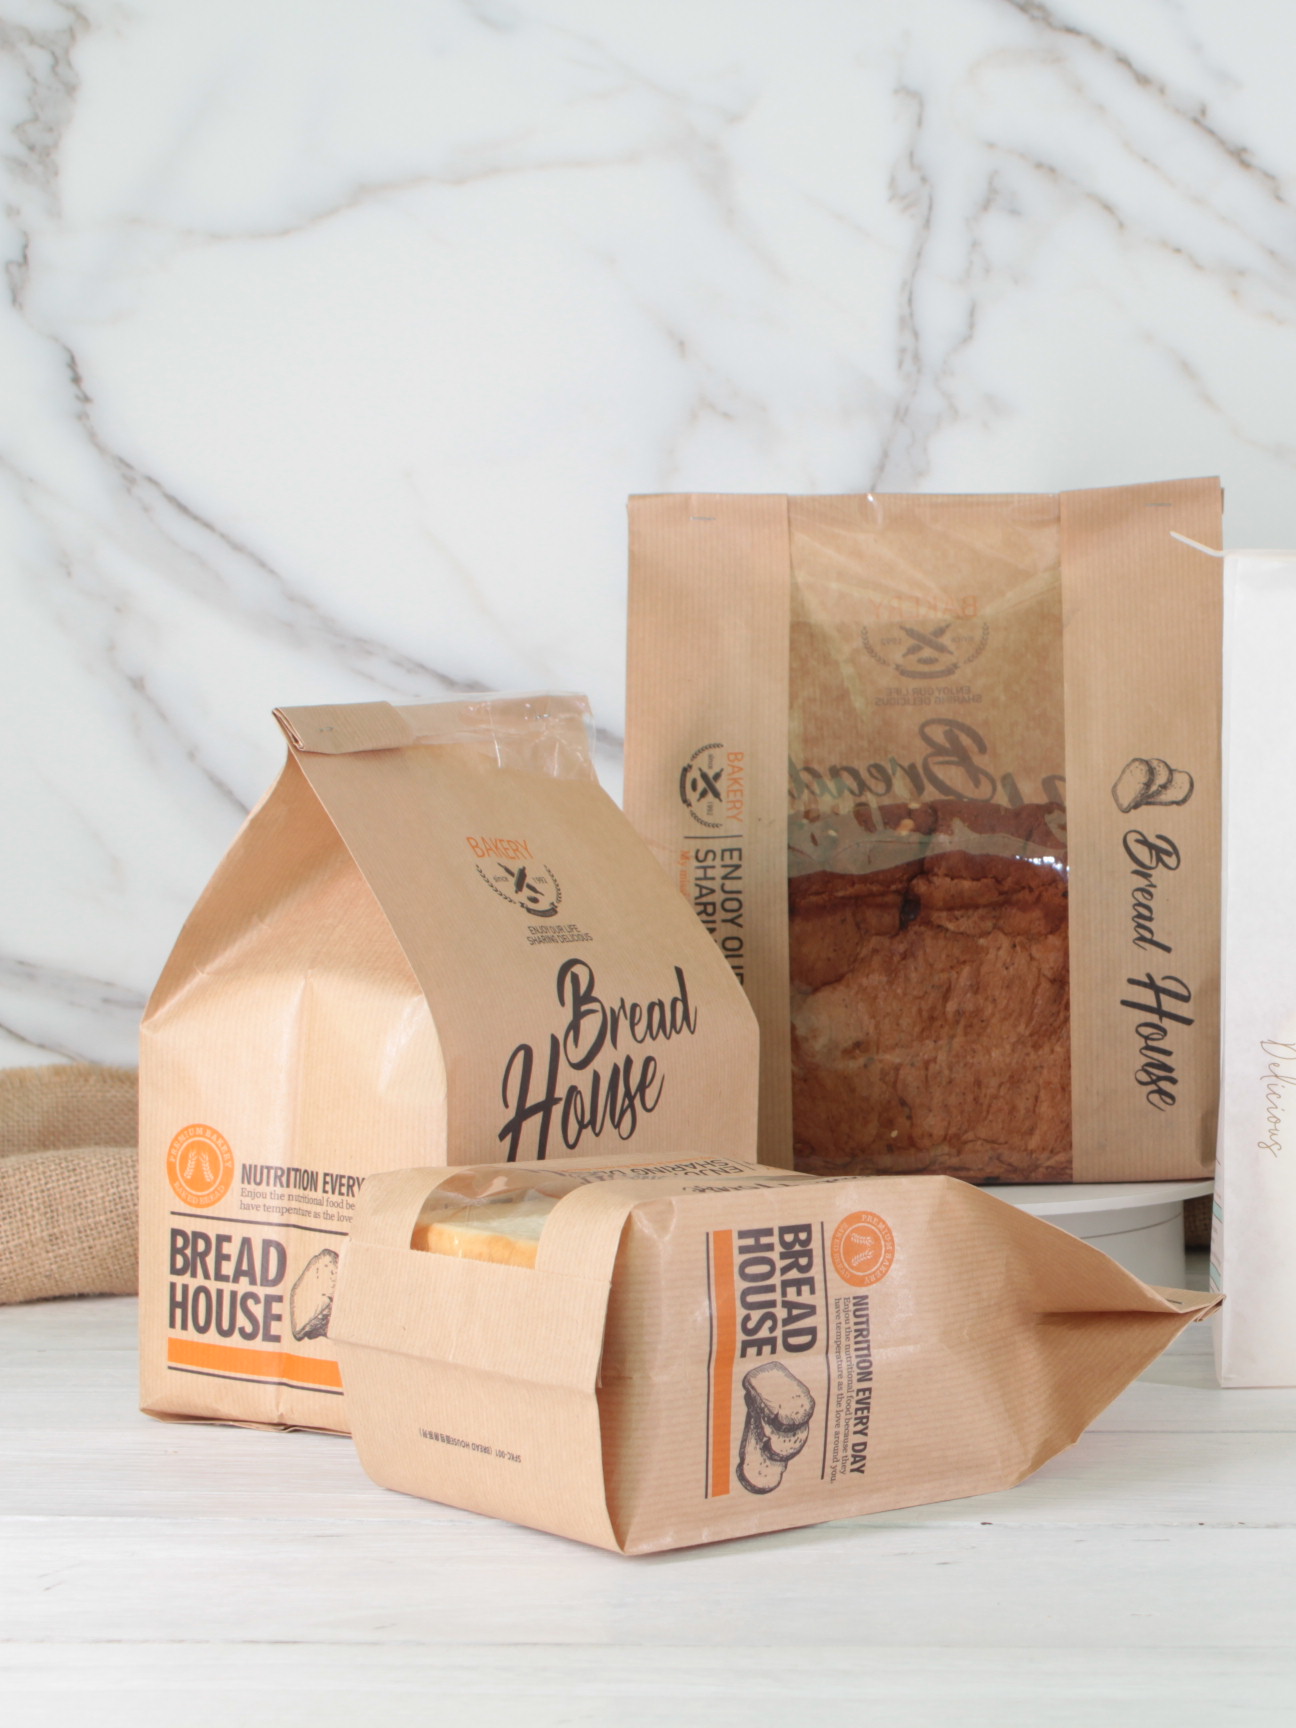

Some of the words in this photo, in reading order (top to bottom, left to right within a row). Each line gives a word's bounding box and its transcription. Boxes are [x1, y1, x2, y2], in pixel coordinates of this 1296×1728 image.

[726, 752, 744, 823] BAKERY
[466, 836, 534, 860] BAKERY
[694, 848, 717, 943] SHARI
[720, 847, 743, 928] ENJOY
[1122, 829, 1181, 954] Bread
[526, 936, 558, 945] SHARING
[557, 933, 593, 944] DELICIOUS
[527, 925, 549, 935] ENJOY
[550, 925, 565, 934] OUR
[564, 924, 581, 934] LIFE
[721, 936, 744, 986] OU
[556, 957, 698, 1071] Bread
[1120, 973, 1195, 1112] House
[498, 1033, 665, 1163] House
[169, 1127, 204, 1162] PREMIUM
[205, 1128, 233, 1168] BAKERY
[241, 1163, 318, 1193] NUTRITION
[322, 1173, 366, 1198] EVERY
[269, 1189, 285, 1201] the
[326, 1197, 344, 1209] food
[240, 1200, 261, 1211] have
[313, 1210, 321, 1219] as
[322, 1210, 335, 1220] the
[861, 1214, 893, 1250] PREMIUM
[169, 1227, 288, 1288] BREAD
[737, 1227, 778, 1358] HOUSE
[778, 1223, 817, 1353] BREAD
[834, 1297, 842, 1320] have
[168, 1281, 284, 1344] HOUSE
[834, 1322, 843, 1379] temperature
[852, 1294, 873, 1383] NUTRITION
[837, 1381, 843, 1391] as
[845, 1344, 854, 1394] nutritional
[835, 1409, 843, 1428] love
[836, 1393, 844, 1408] the
[845, 1394, 854, 1416] food
[852, 1387, 872, 1437] EVERY
[832, 1430, 840, 1463] around
[842, 1416, 852, 1453] because
[840, 1455, 849, 1474] they
[849, 1441, 868, 1474] DAY
